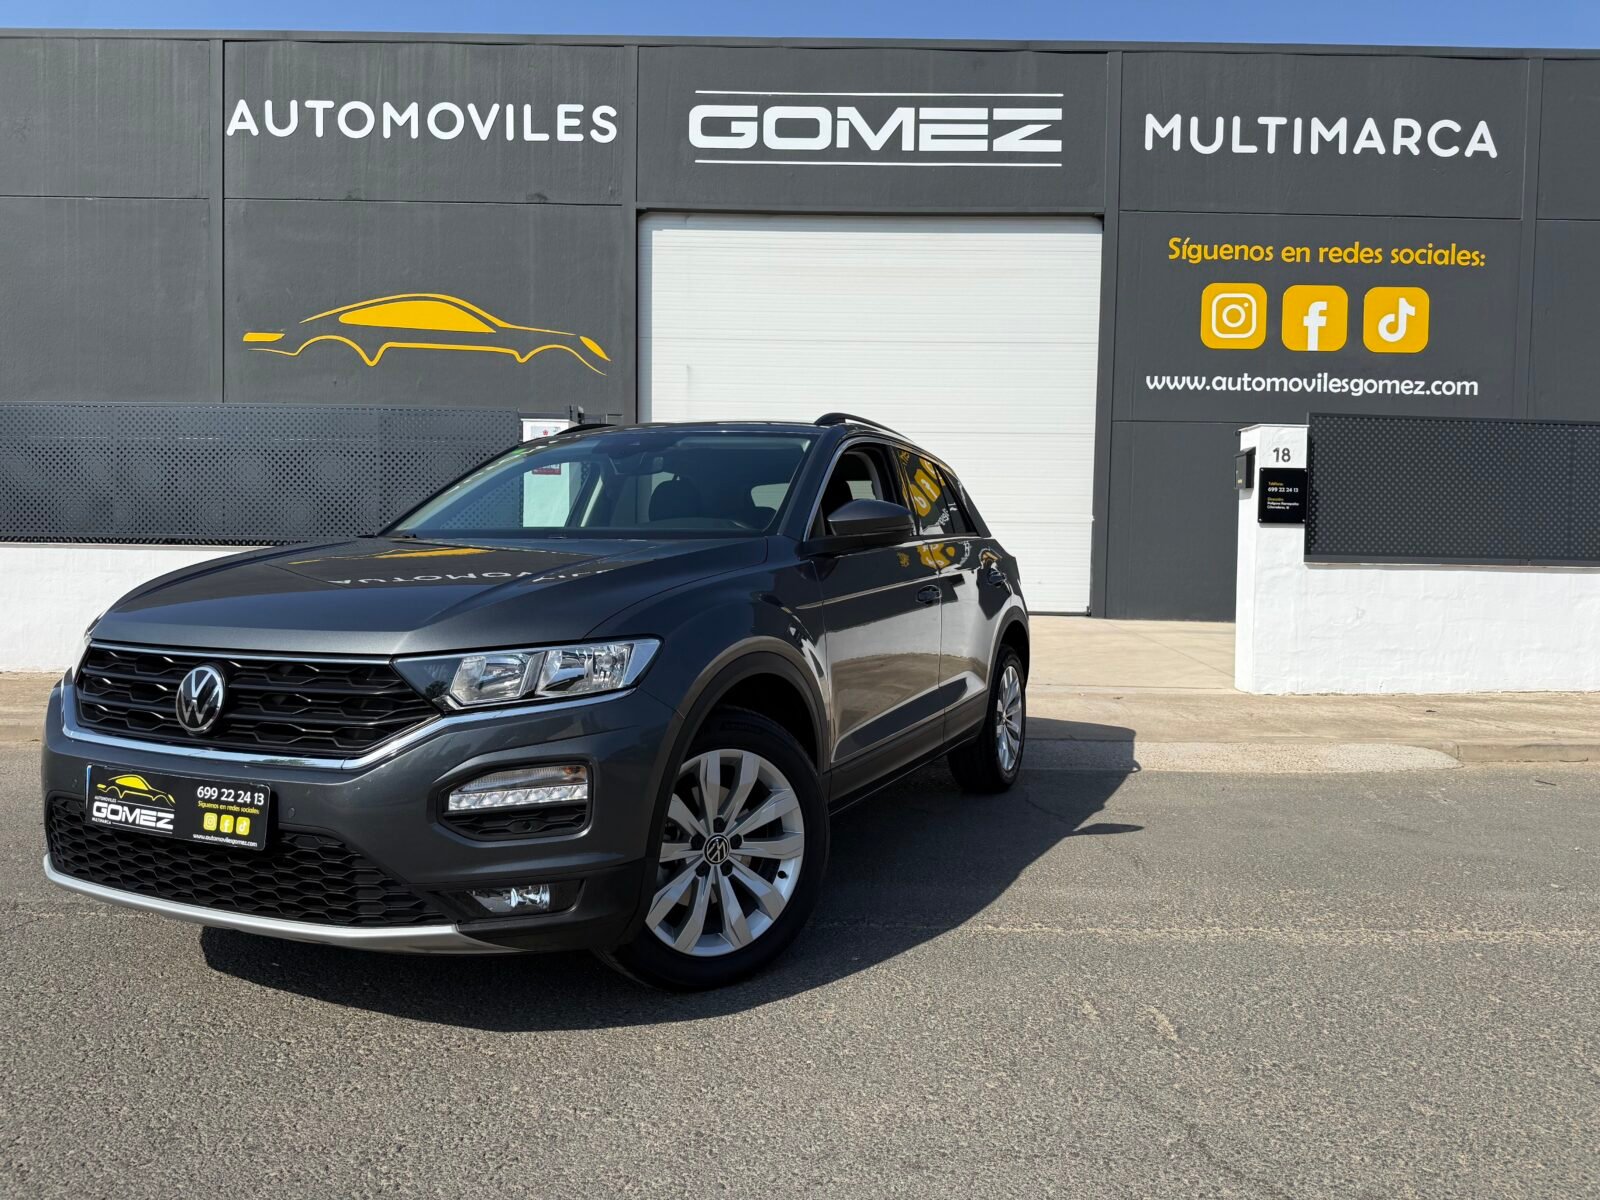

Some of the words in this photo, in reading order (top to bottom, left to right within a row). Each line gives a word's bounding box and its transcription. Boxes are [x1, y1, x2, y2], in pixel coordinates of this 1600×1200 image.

[226, 98, 618, 144] AUTOMOVILES
[688, 104, 1063, 153] GOMEZ
[1144, 113, 1498, 159] MULTIMARCA
[1168, 236, 1275, 266] Síguenos
[1280, 245, 1312, 264] en
[1317, 240, 1384, 266] redes
[1390, 242, 1487, 267] sociales:
[1145, 372, 1480, 397] www.automovilesgomez.com
[1273, 447, 1291, 463] 18
[197, 786, 218, 800] 699
[220, 788, 235, 802] 22
[237, 790, 252, 804] 24
[254, 792, 265, 806] 13
[227, 804, 240, 812] redes
[92, 800, 175, 830] GOMEZ
